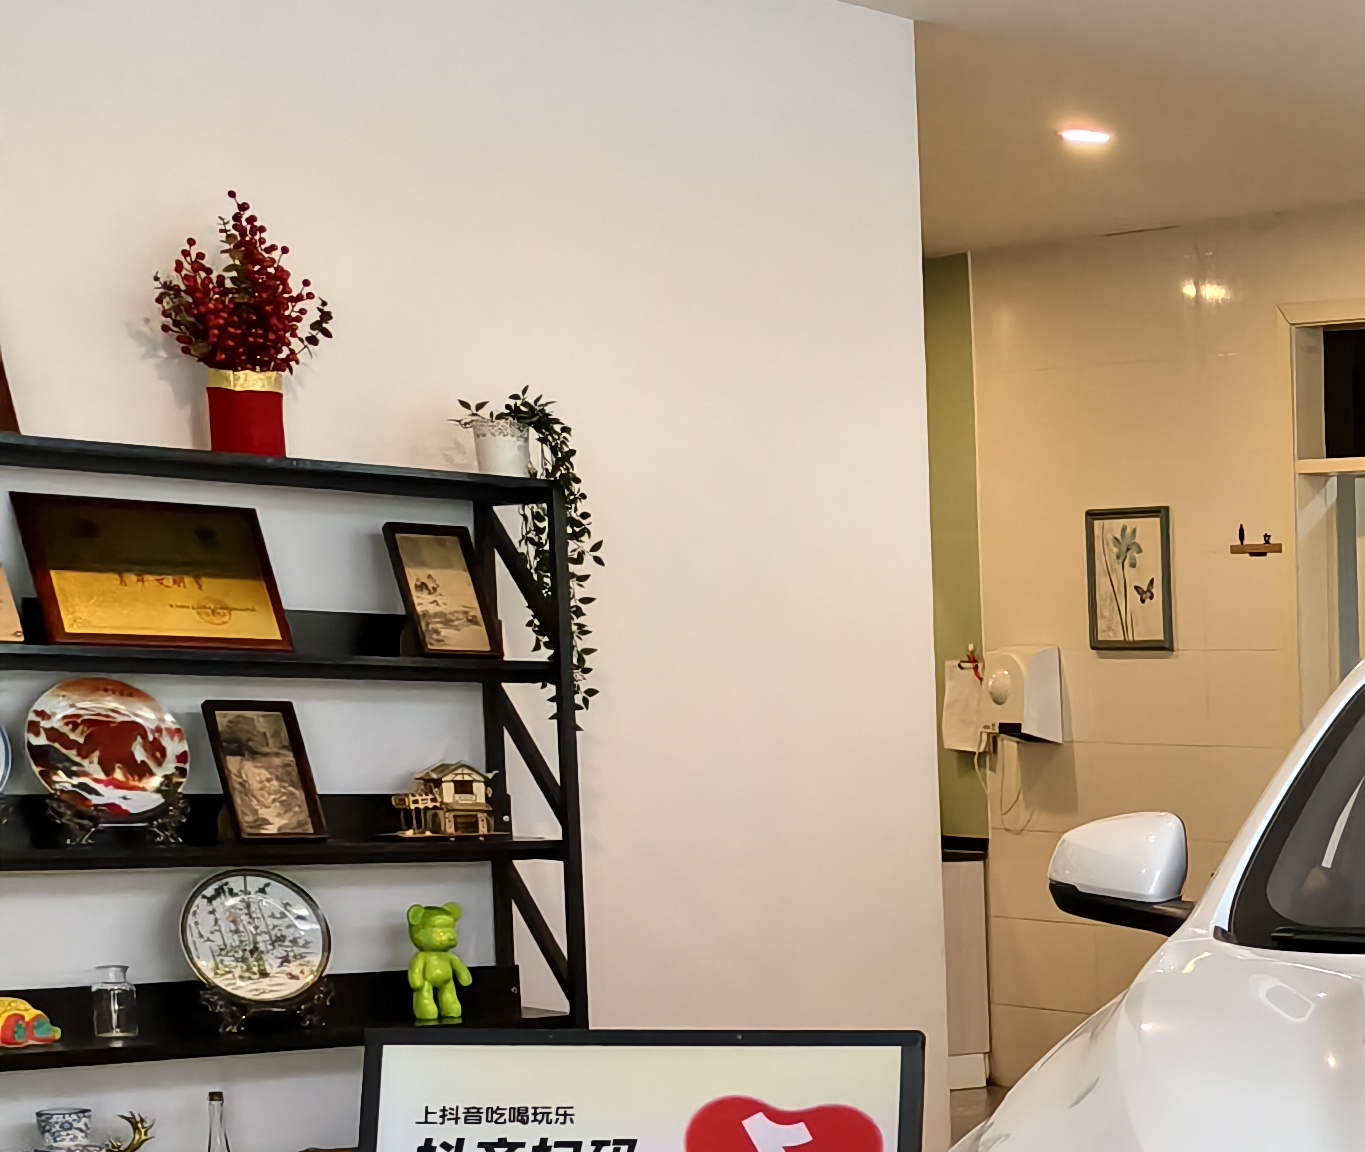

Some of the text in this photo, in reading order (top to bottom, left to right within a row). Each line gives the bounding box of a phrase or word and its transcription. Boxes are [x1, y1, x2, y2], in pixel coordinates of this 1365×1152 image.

[415, 1104, 576, 1127] 上抖音吃喝玩乐
